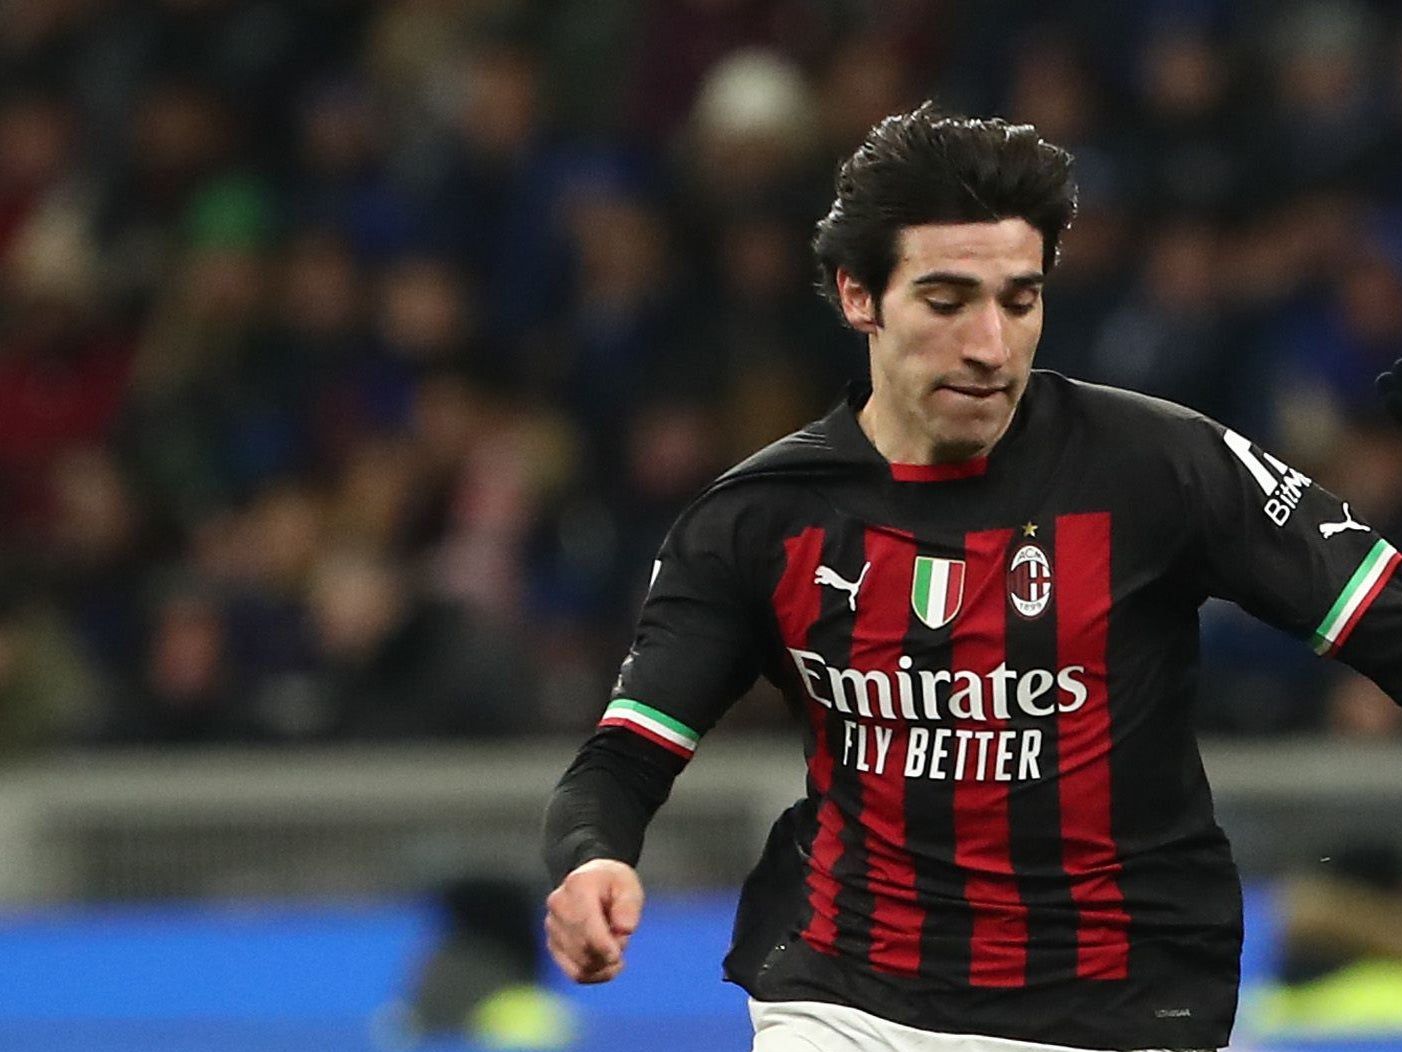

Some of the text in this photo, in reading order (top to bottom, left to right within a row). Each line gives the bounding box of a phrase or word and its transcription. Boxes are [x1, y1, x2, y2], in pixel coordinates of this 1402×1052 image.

[787, 647, 1088, 721] Emirates
[843, 719, 1043, 782] FLY BETTER
